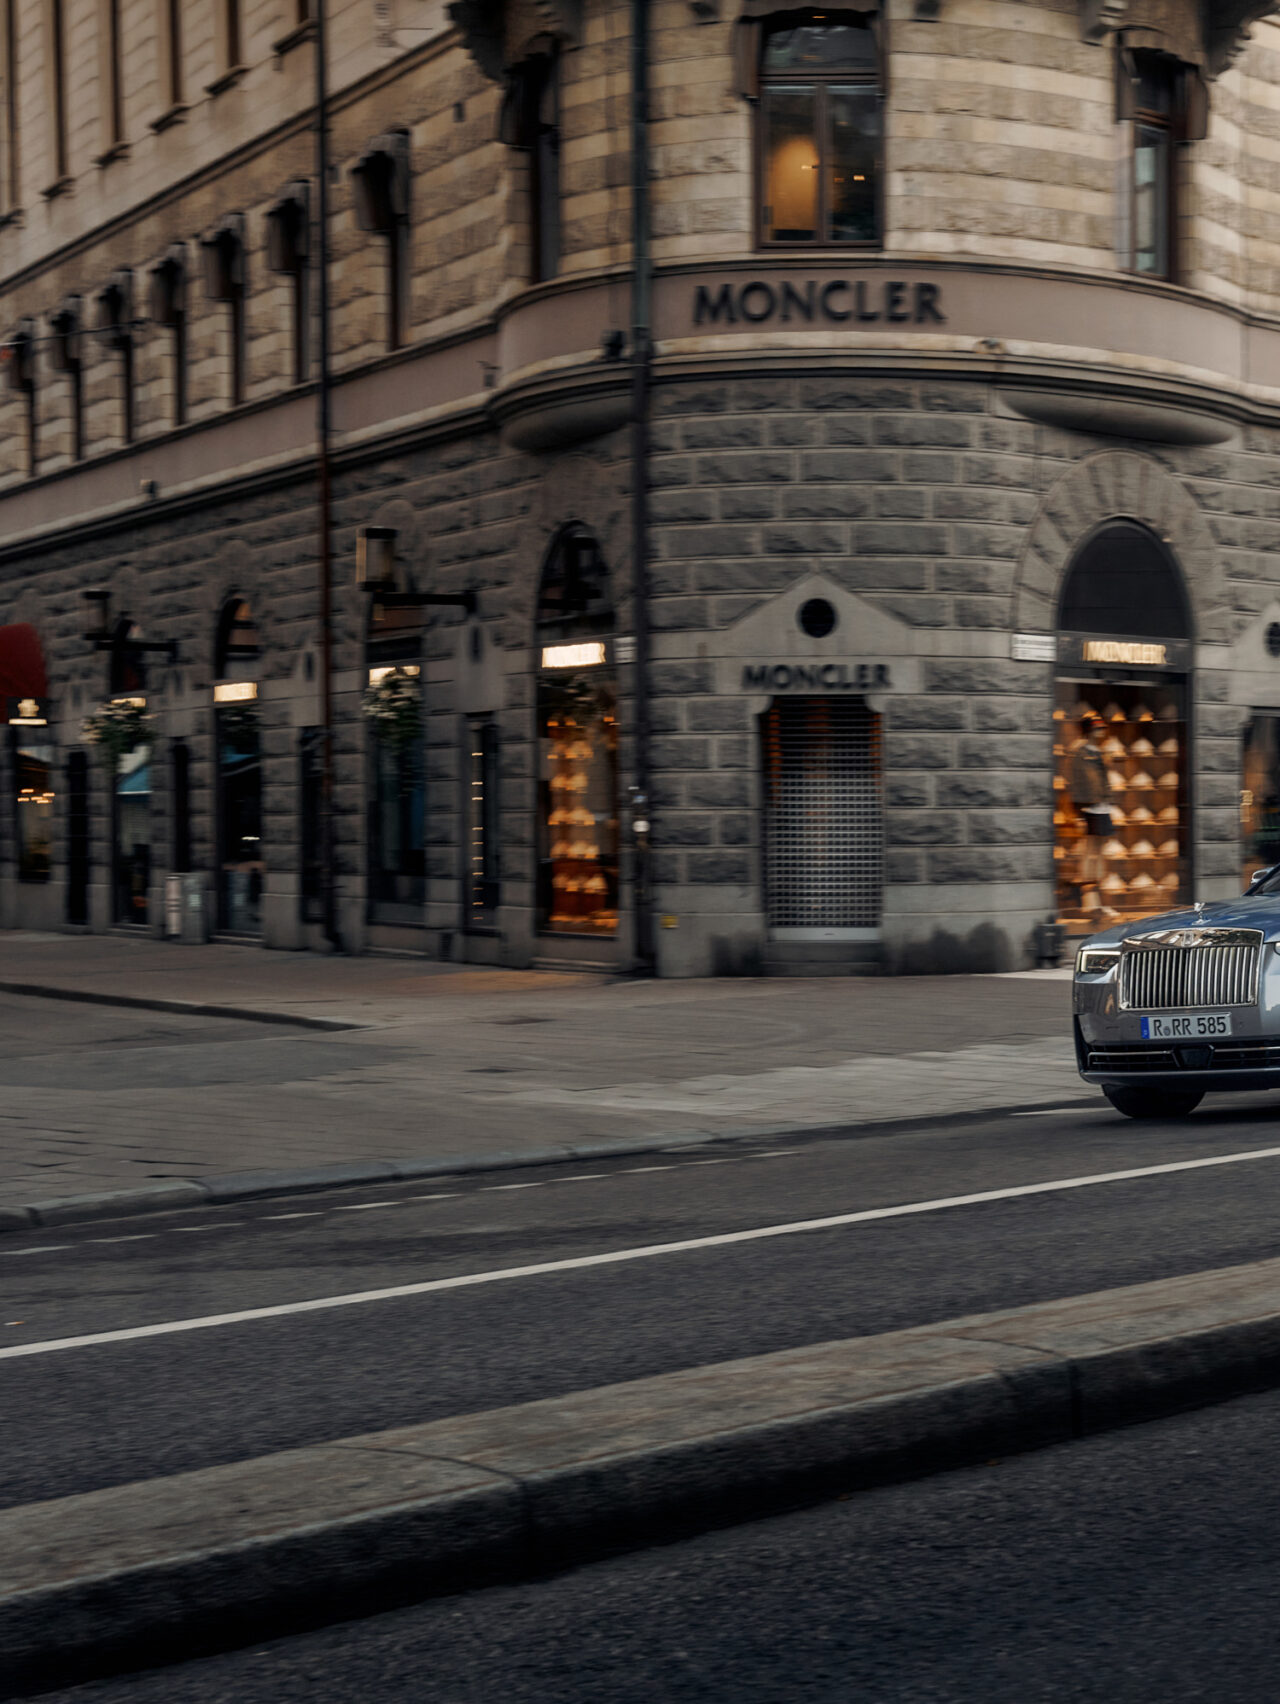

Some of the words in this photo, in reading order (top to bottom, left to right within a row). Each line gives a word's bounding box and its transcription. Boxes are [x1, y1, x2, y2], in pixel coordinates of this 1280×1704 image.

[693, 280, 948, 325] MONCLER
[741, 664, 894, 690] MONCLER
[1197, 1016, 1227, 1035] 585
